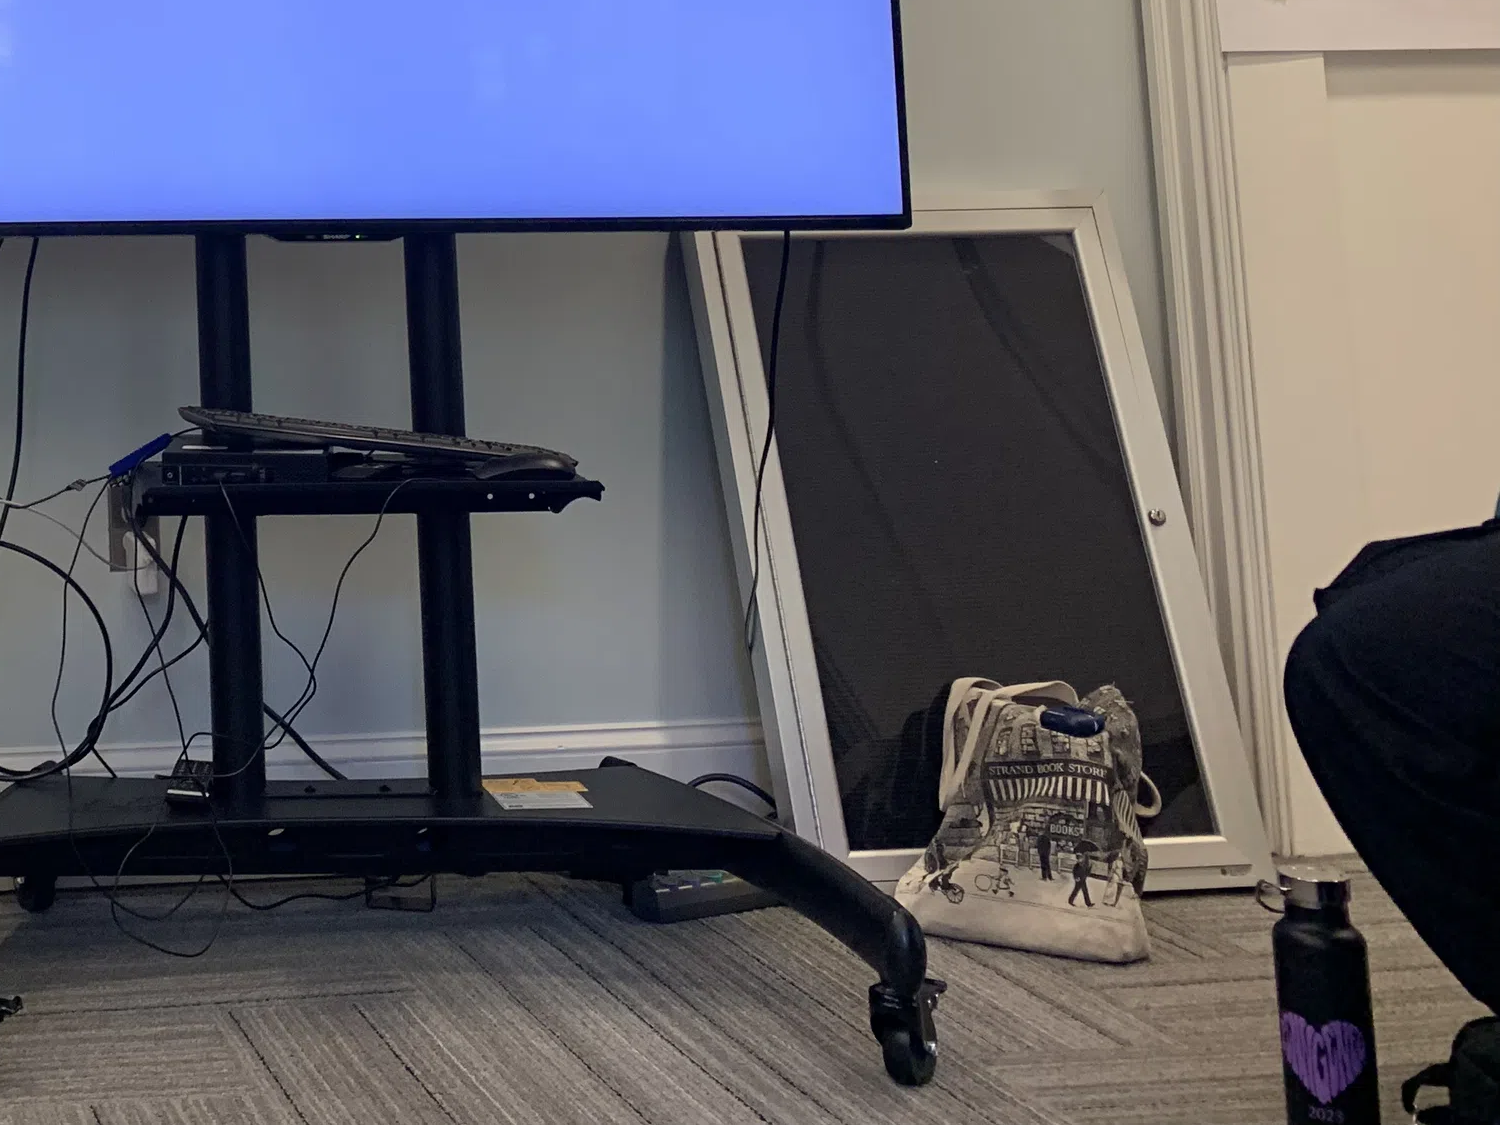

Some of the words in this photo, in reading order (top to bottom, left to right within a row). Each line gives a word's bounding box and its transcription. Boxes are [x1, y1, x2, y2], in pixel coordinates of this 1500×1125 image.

[988, 765, 1033, 775] STRAND
[1037, 762, 1064, 773] BOOK
[1051, 824, 1080, 836] BOOKS
